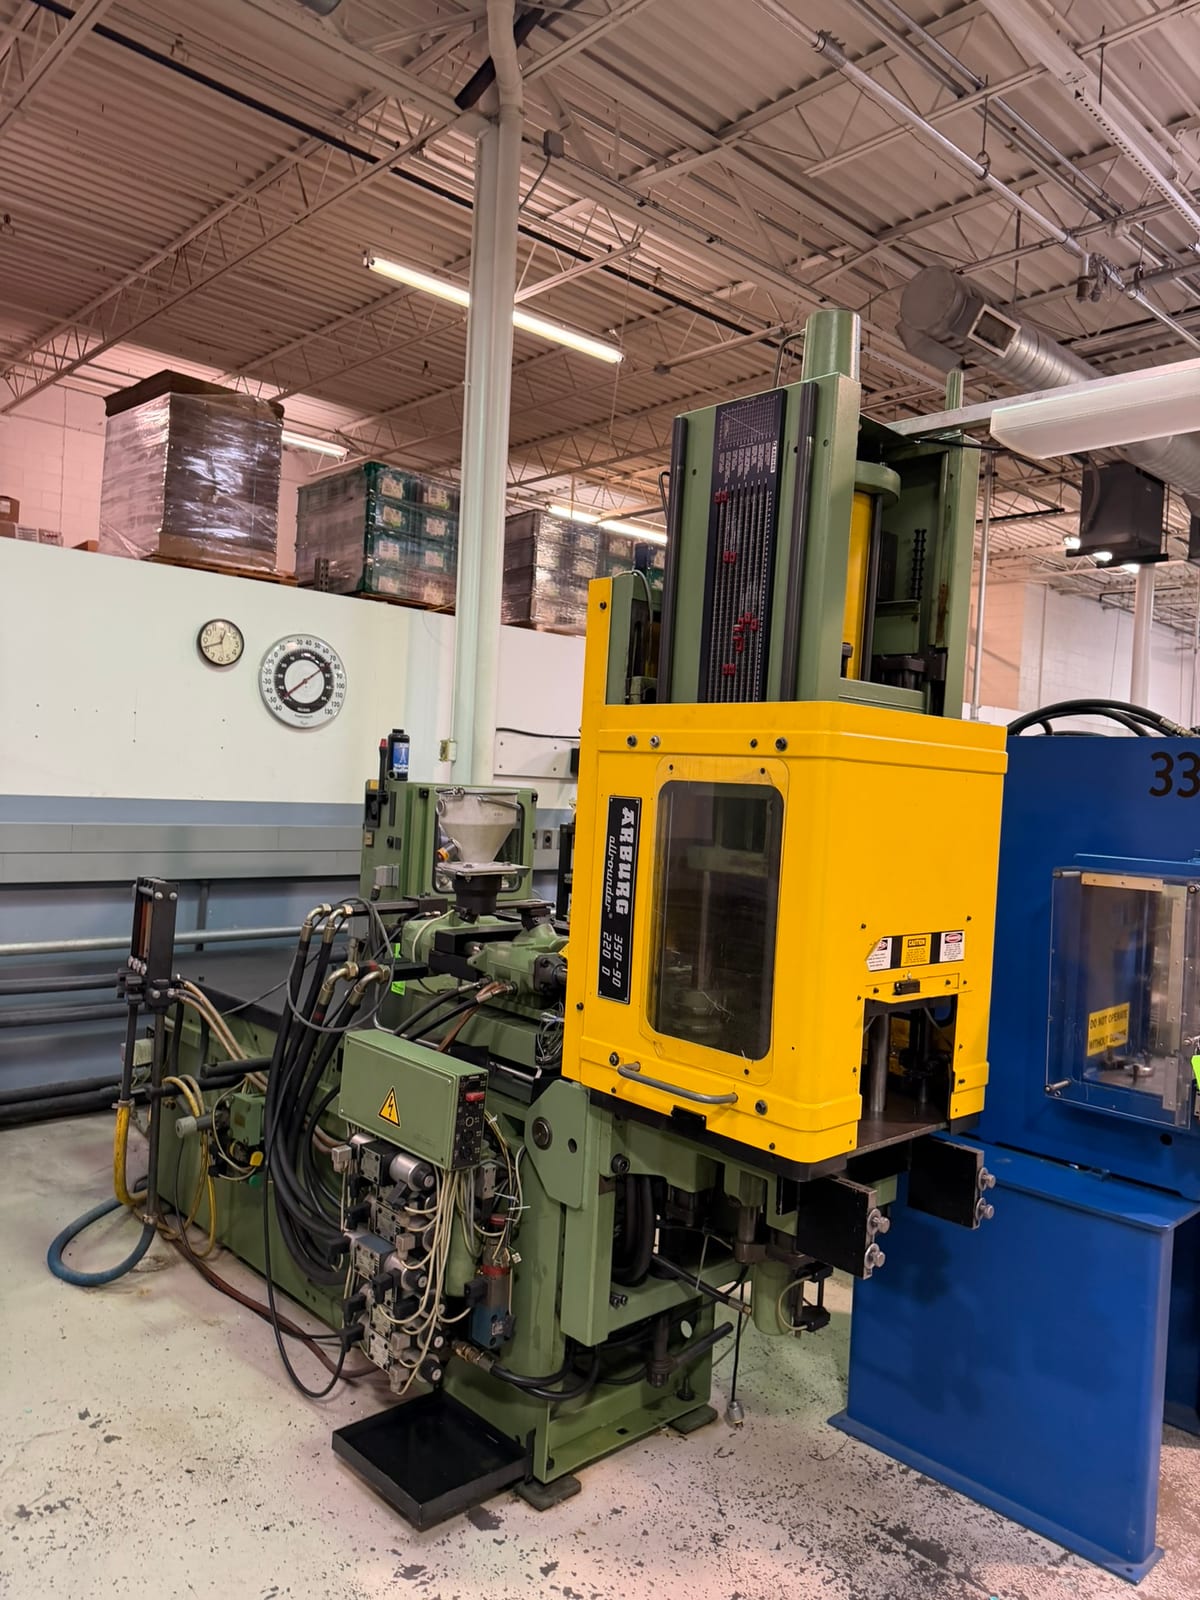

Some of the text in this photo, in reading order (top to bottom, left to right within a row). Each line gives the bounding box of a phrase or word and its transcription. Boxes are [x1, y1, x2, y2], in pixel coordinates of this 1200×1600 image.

[615, 806, 635, 916] ARBURG
[602, 931, 612, 959] 220
[612, 933, 623, 988] 350-90
[1090, 1018, 1097, 1029] DO
[1098, 1015, 1108, 1026] NOT
